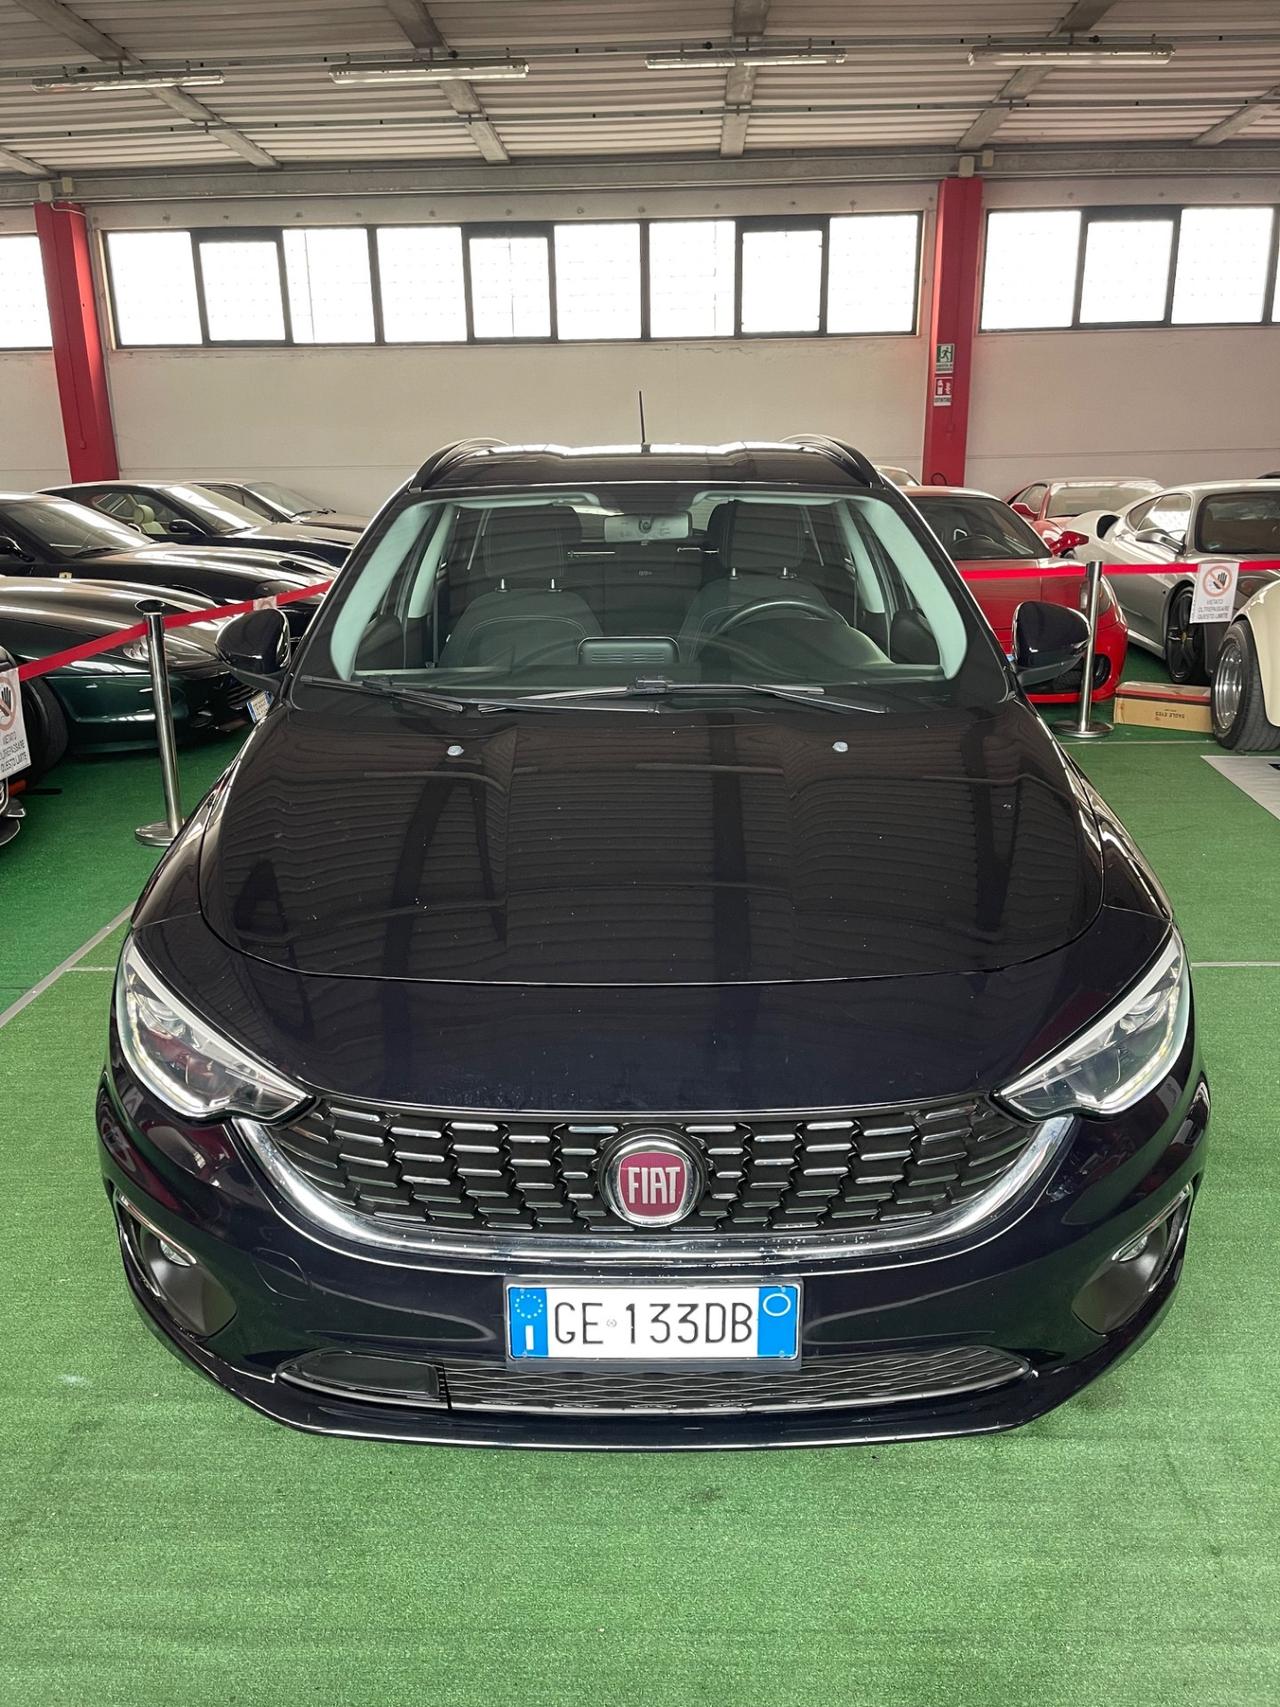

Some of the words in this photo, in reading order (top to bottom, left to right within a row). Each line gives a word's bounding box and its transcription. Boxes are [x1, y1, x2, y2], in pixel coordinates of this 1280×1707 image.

[627, 1166, 681, 1205] FIAT
[554, 1302, 604, 1345] GE
[625, 1301, 753, 1345] 133DB
